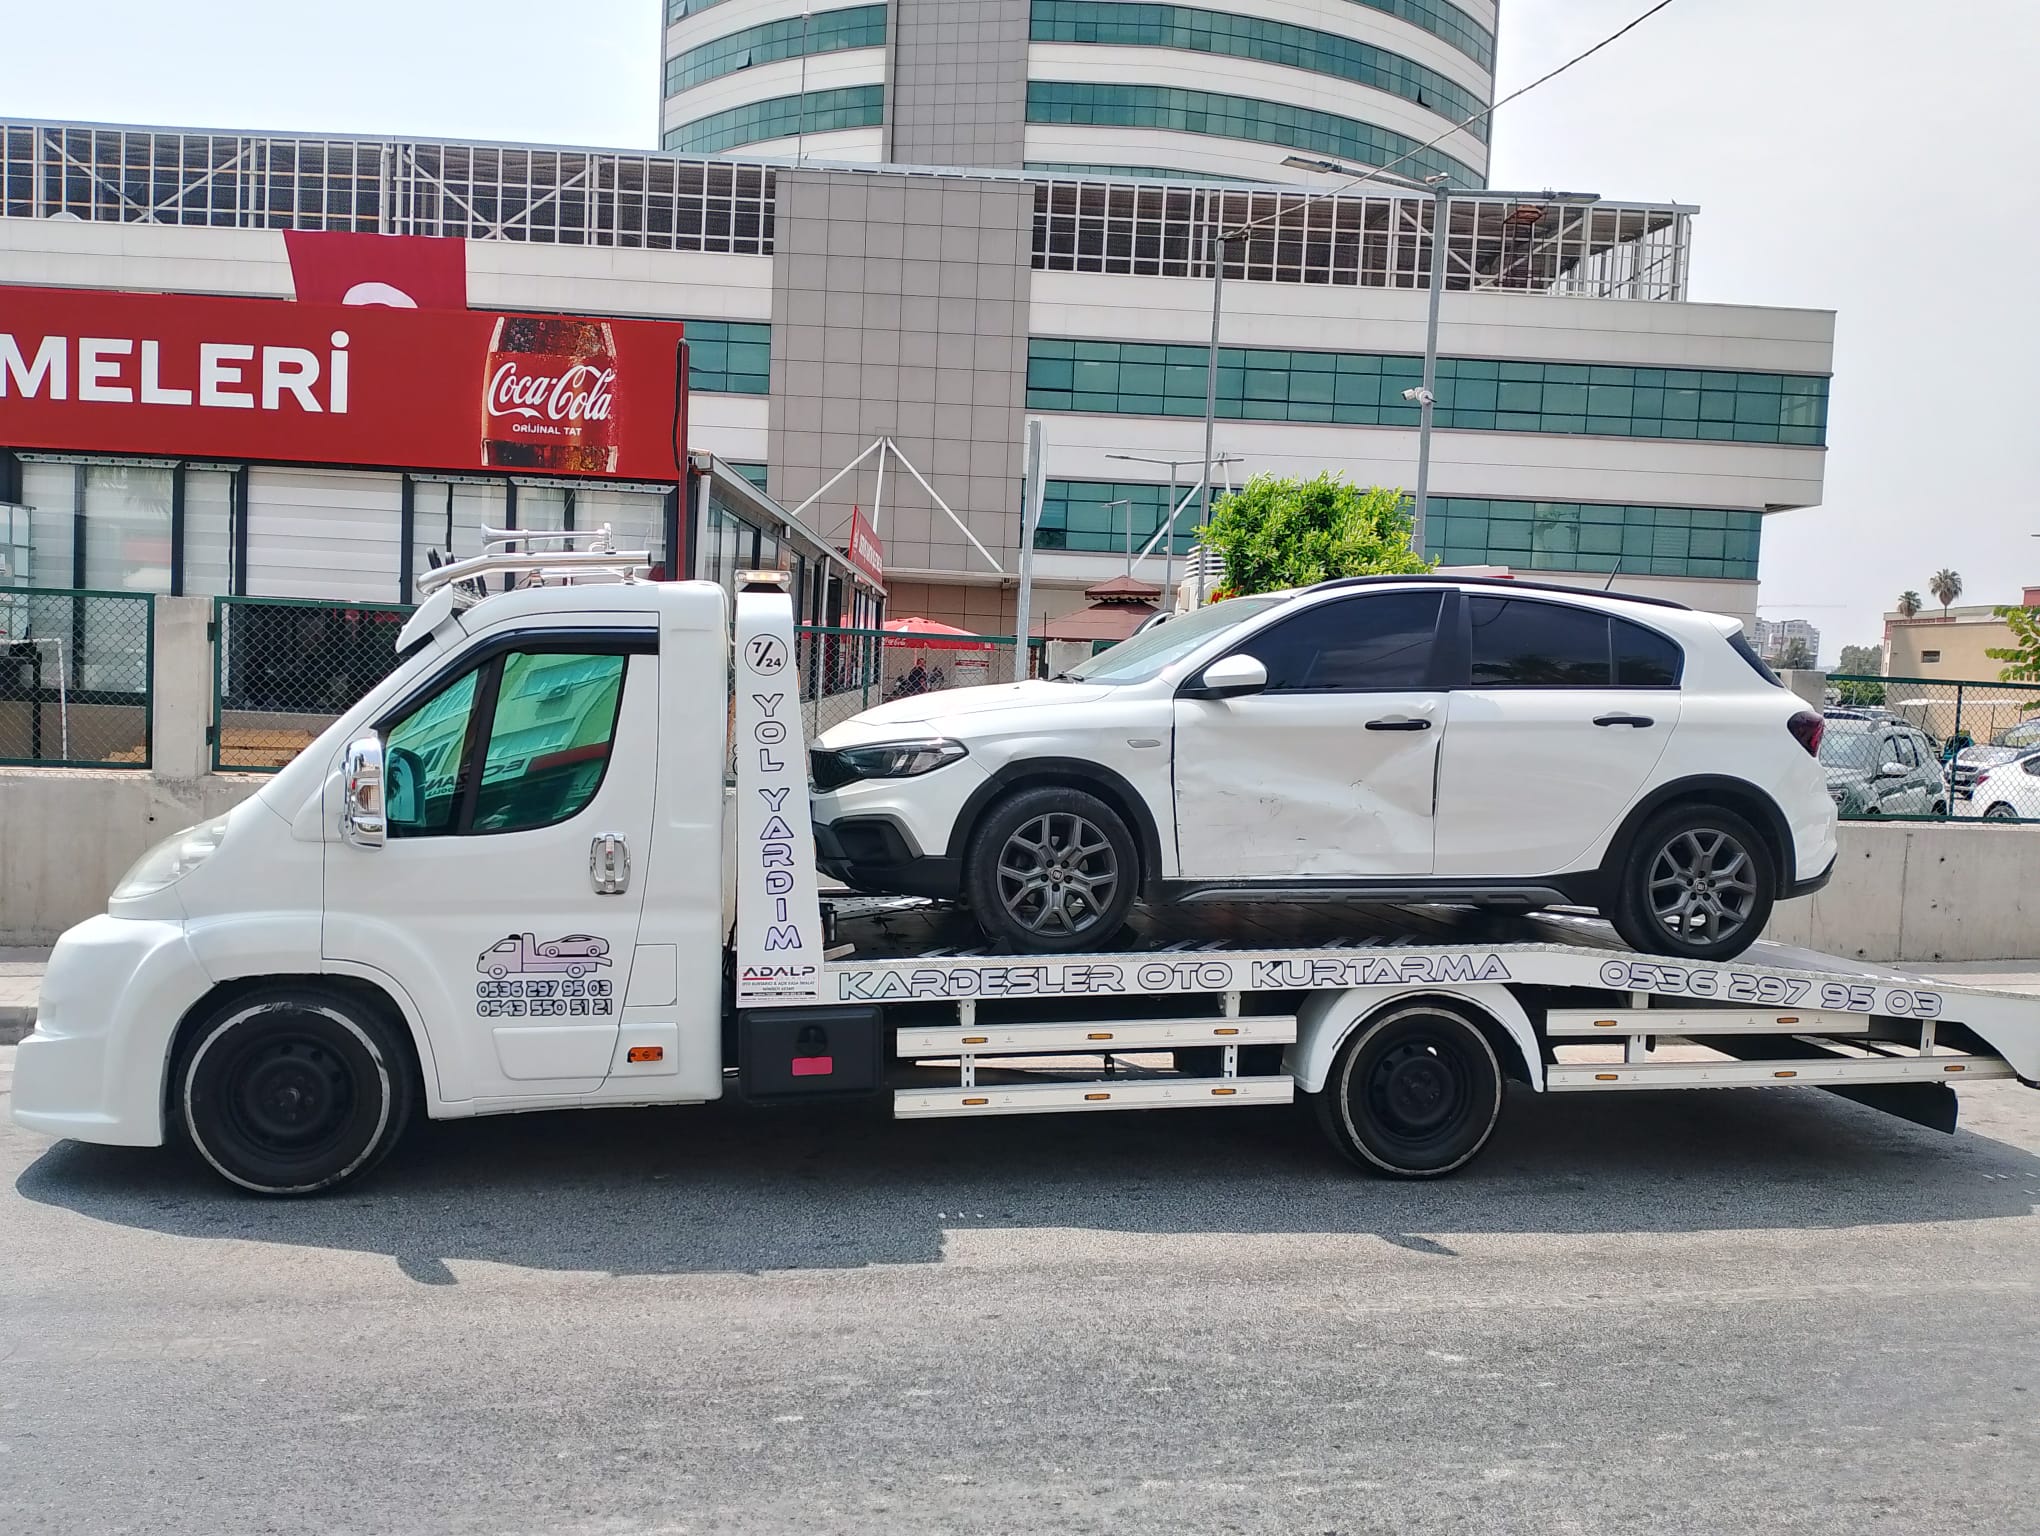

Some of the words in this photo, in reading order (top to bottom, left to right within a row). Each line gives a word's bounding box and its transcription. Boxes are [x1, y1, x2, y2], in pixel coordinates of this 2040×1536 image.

[0, 330, 350, 415] MELERİ
[487, 361, 616, 421] Coca-Cola
[512, 423, 561, 436] ORİJİNAL
[564, 427, 583, 437] TAT
[752, 641, 782, 668] 7/24
[752, 693, 787, 773] YOL
[758, 787, 803, 952] YARDIM
[476, 980, 524, 998] 0536
[525, 980, 560, 998] 297
[561, 979, 586, 997] 95
[587, 979, 613, 997] 03
[742, 966, 816, 977] ADALP
[1136, 961, 1233, 990] OTO
[1250, 953, 1513, 989] KURTARMA
[1599, 959, 1719, 997] 0536
[1727, 972, 1812, 1006] 297
[1820, 982, 1876, 1013] 95
[1884, 989, 1943, 1018] 03
[476, 999, 528, 1017] 0543
[529, 999, 568, 1017] 550
[569, 998, 590, 1016] 51
[592, 998, 613, 1016] 21
